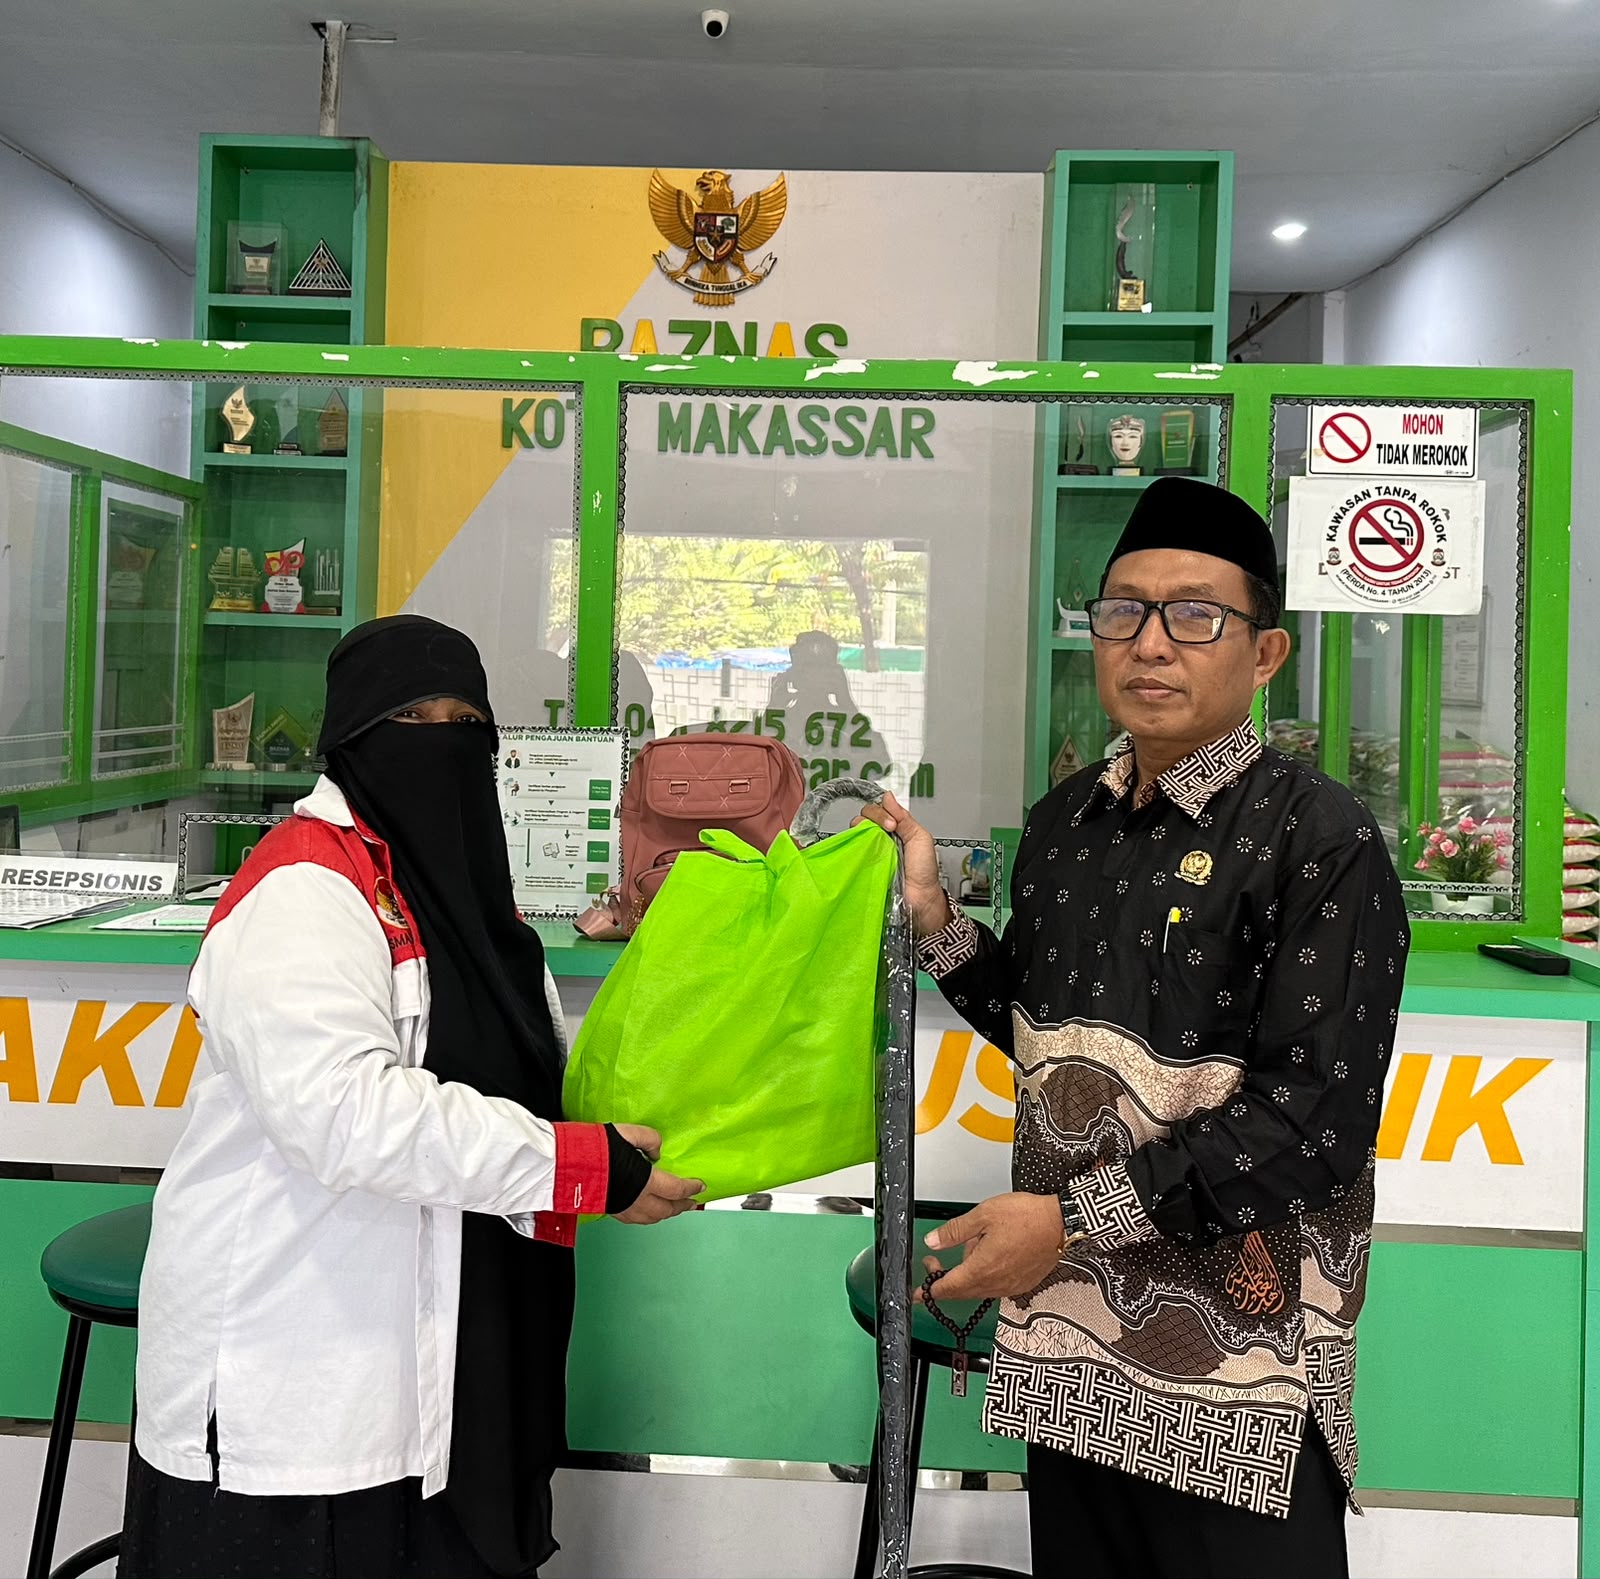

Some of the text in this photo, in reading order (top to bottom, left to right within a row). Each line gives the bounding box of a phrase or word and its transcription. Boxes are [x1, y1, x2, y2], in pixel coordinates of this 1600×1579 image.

[658, 401, 936, 459] MAKASSAR
[1402, 413, 1444, 435] MOHON
[1376, 443, 1468, 466] TIDAK MEROKOK
[1326, 485, 1448, 544] KAWASAN TANPA ROKOK
[1388, 582, 1415, 597] TAHUN
[502, 734, 615, 743] ALUR PENGAJUAN BANTUAN
[805, 711, 872, 748] 672
[1, 868, 163, 892] RESEPSIONIS
